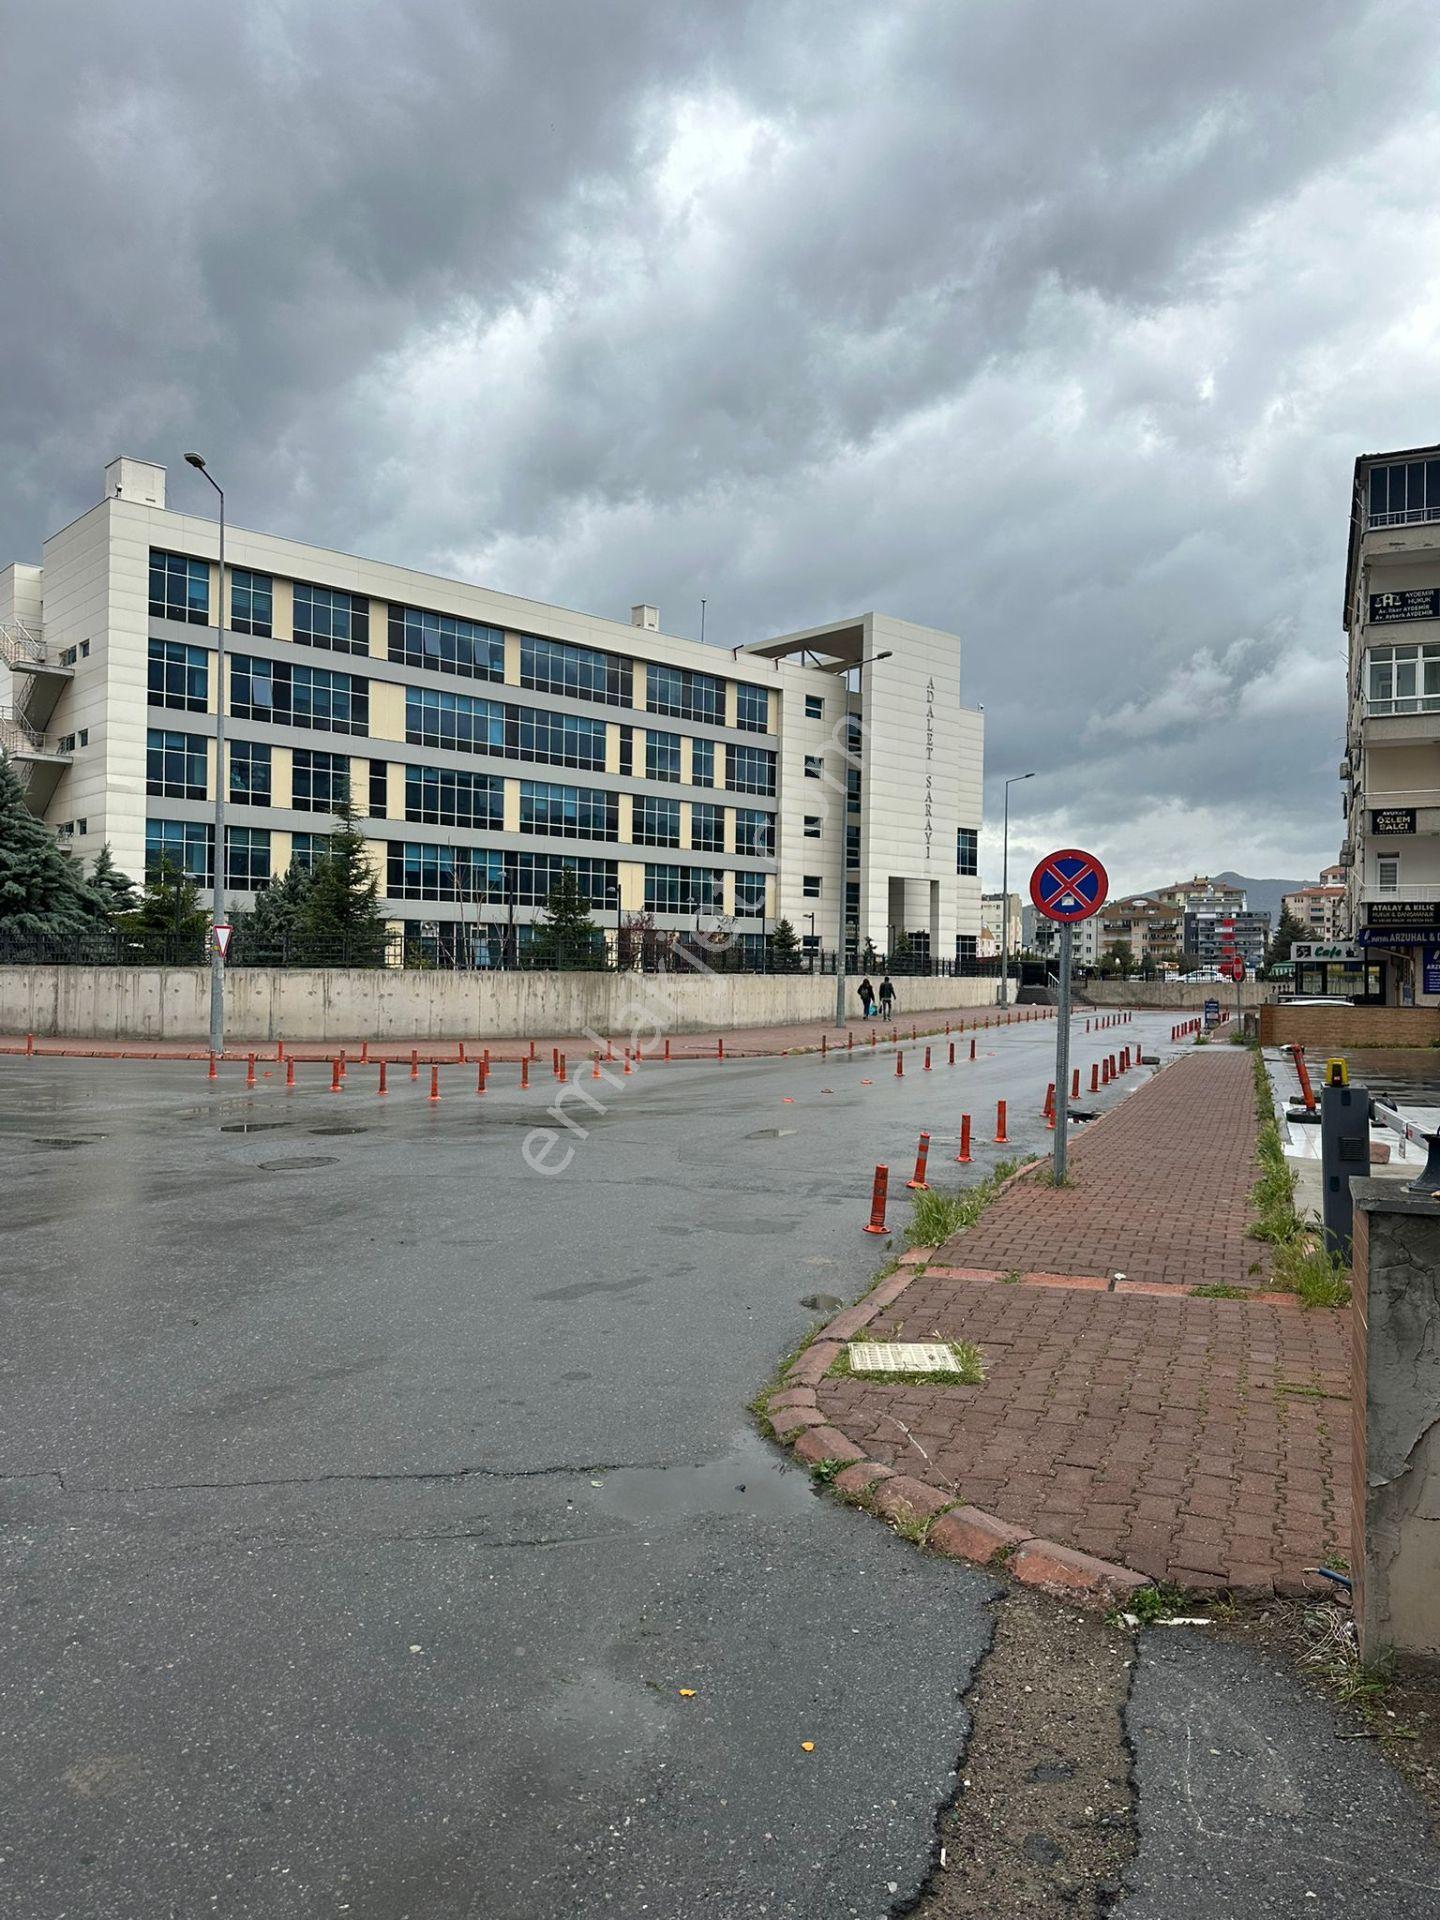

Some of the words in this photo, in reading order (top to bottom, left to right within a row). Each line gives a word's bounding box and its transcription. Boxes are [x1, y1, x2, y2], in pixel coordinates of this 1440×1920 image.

[926, 676, 935, 760] ADALET
[924, 775, 933, 859] SARAYI
[1390, 933, 1427, 942] ARZUHAL
[1430, 933, 1434, 942] &
